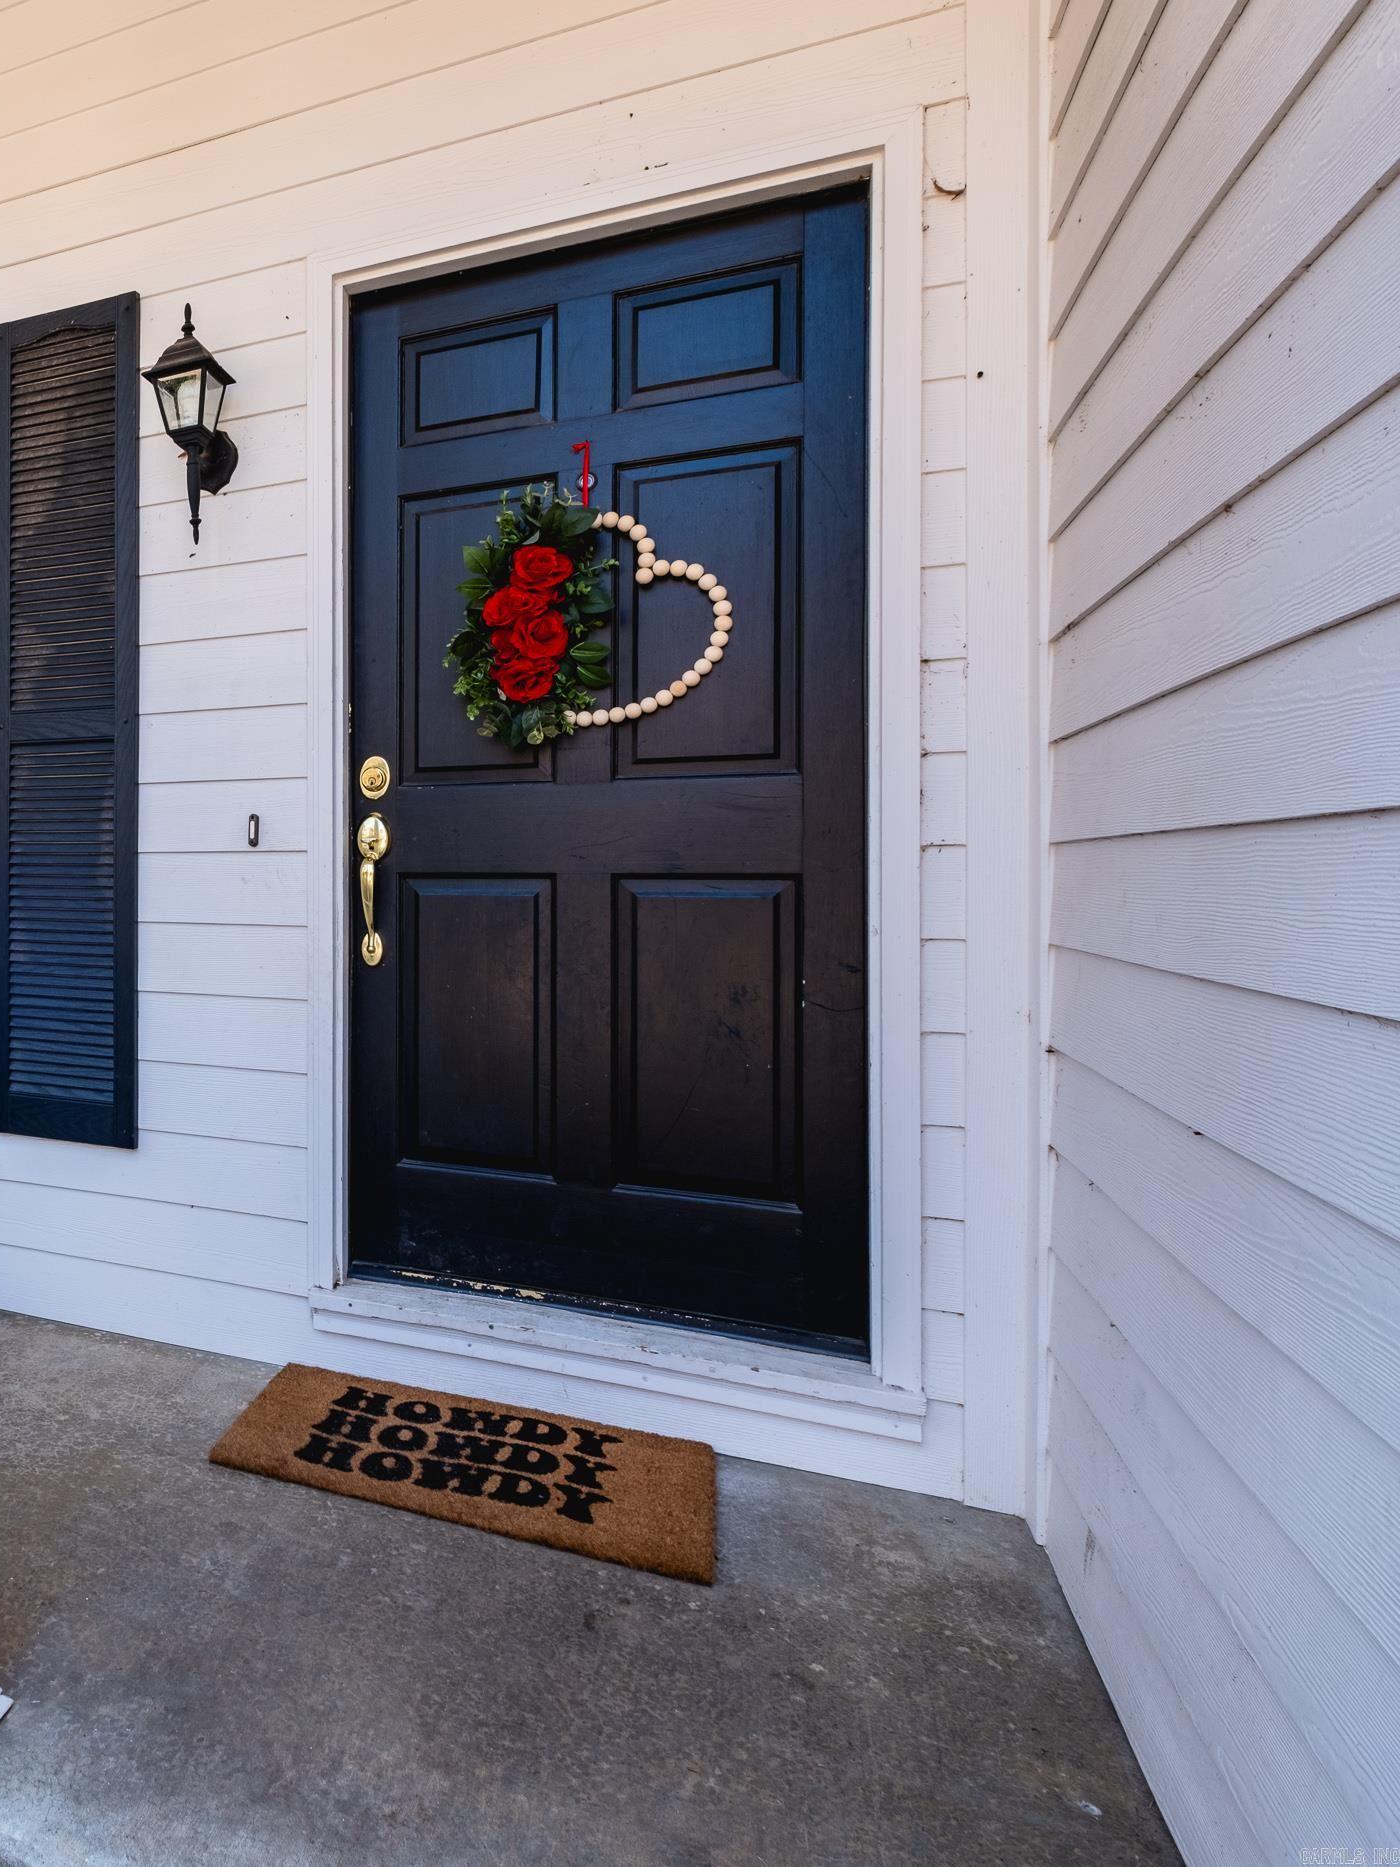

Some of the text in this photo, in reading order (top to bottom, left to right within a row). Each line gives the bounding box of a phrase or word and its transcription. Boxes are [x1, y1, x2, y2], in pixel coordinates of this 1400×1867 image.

[311, 1407, 618, 1490] HOWDY
[330, 1385, 624, 1458] HOWDY
[294, 1432, 613, 1524] HOWDY
